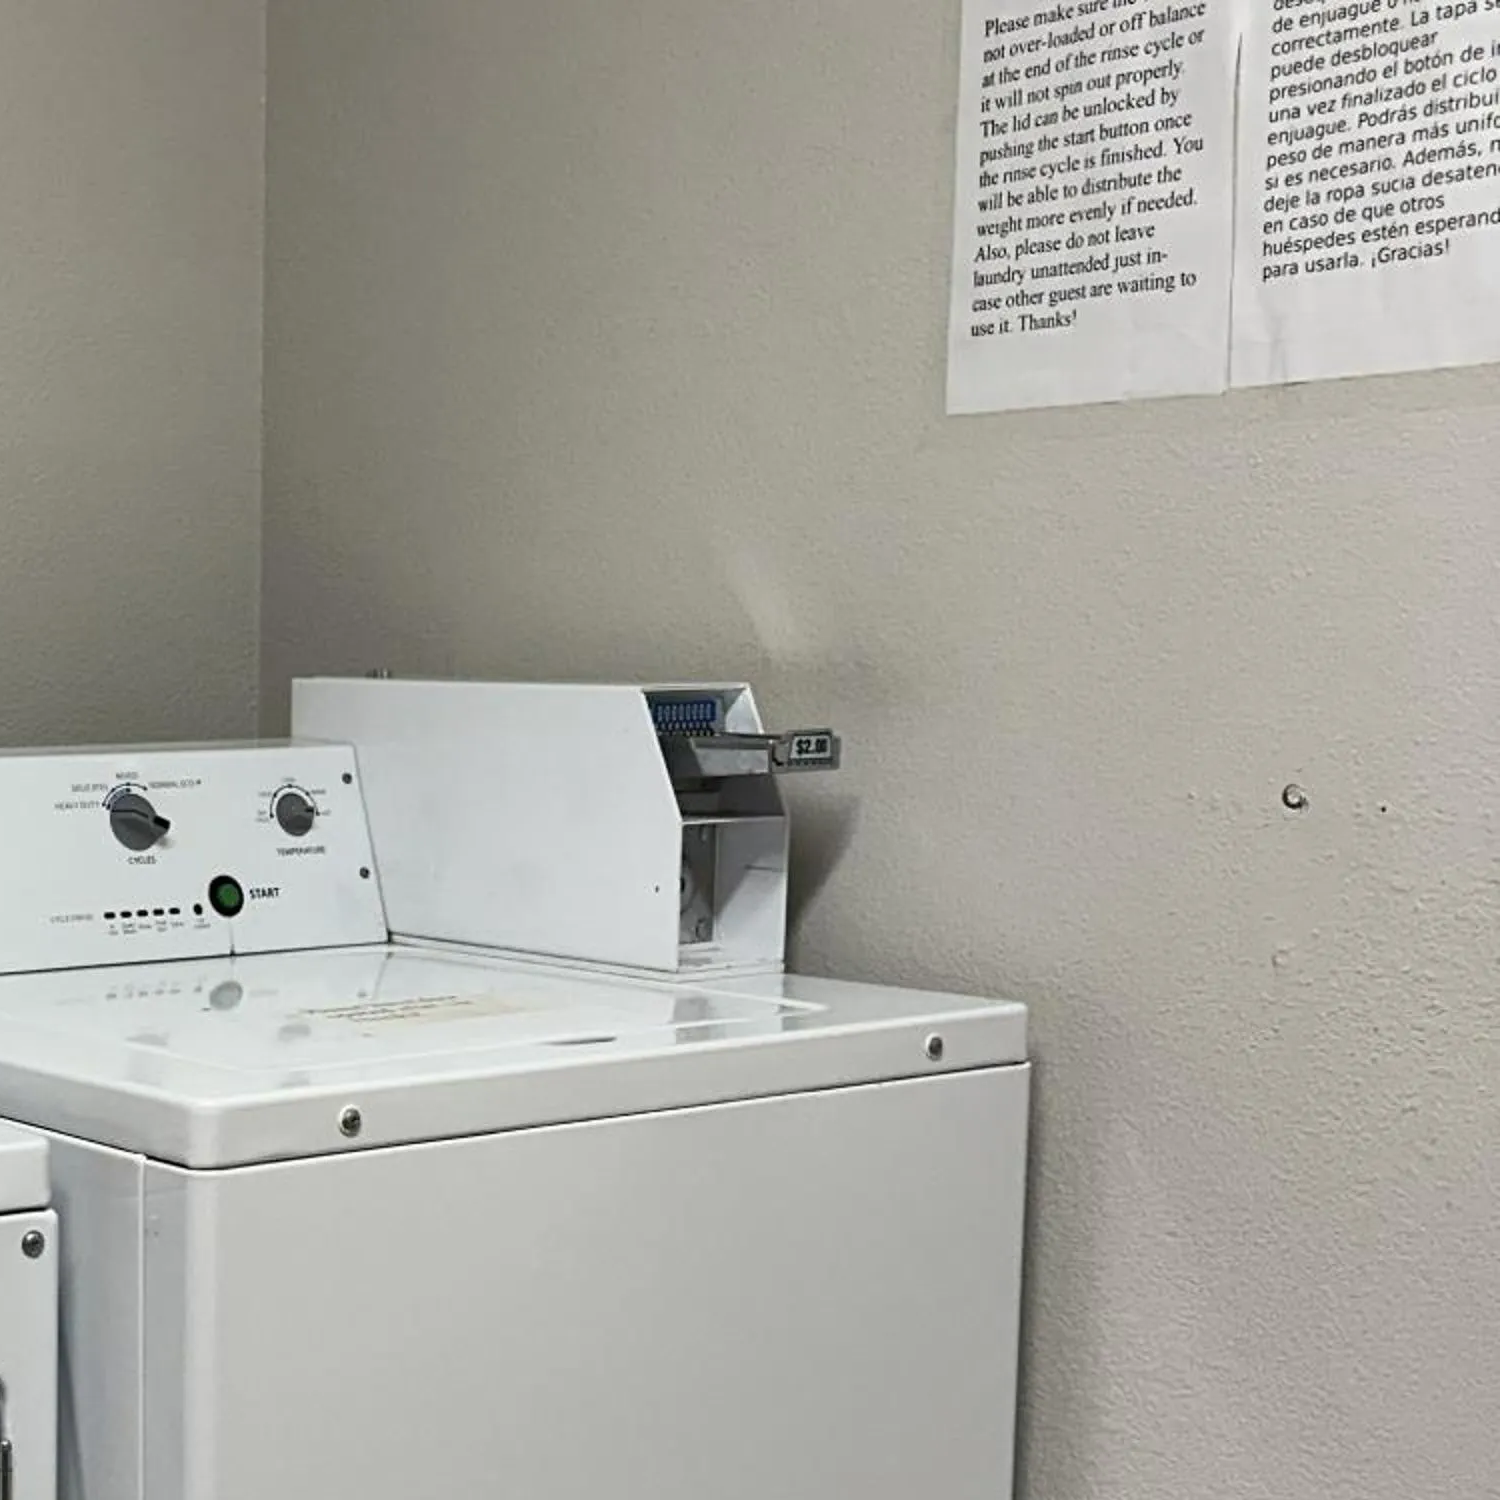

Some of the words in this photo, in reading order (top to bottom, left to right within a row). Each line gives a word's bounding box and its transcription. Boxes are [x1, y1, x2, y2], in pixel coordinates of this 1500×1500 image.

[983, 44, 1006, 64] not
[1009, 21, 1095, 57] over-loaded
[1100, 21, 1116, 38] or
[1119, 10, 1147, 33] off
[1149, 2, 1206, 28] balance
[984, 15, 1030, 38] Please
[1033, 4, 1074, 27] make
[1077, 0, 1108, 17] sure
[1271, 15, 1294, 35] de
[1299, 0, 1382, 29] enjuague
[1411, 10, 1429, 27] La
[1435, 0, 1478, 21] tapa
[982, 71, 995, 89] at
[999, 66, 1021, 85] the
[1025, 57, 1051, 80] end
[1055, 52, 1074, 73] of
[1074, 50, 1097, 69] the
[1101, 44, 1140, 64] rinse
[1144, 31, 1185, 59] cycle
[1188, 29, 1205, 46] or
[1269, 54, 1325, 83] puede
[1330, 31, 1439, 67] desbloquear
[1269, 67, 1378, 105] presionando
[1382, 60, 1399, 80] el
[1403, 52, 1454, 75] botón
[1459, 44, 1485, 63] de
[979, 118, 1008, 139] The
[1013, 111, 1031, 133] lid
[1034, 111, 1059, 128] can
[1062, 104, 1079, 123] be
[1083, 88, 1156, 118] unlocked
[1160, 86, 1179, 108] by
[980, 96, 991, 113] it
[994, 87, 1023, 110] will
[1027, 85, 1050, 105] not
[1053, 80, 1083, 102] spin
[1086, 73, 1111, 91] out
[1268, 105, 1301, 124] una
[1306, 98, 1337, 117] vez
[1341, 79, 1427, 110] finalizado
[1431, 72, 1447, 93] el
[1453, 65, 1498, 89] ciclo
[1357, 103, 1417, 129] Podrás
[979, 141, 1035, 168] pushing
[1037, 134, 1058, 153] the
[1063, 128, 1096, 148] start
[1099, 120, 1150, 141] button
[1154, 113, 1193, 132] once
[979, 170, 999, 189] the
[1002, 166, 1036, 185] rinse
[1039, 155, 1081, 180] cycle
[1083, 155, 1096, 169] is
[1100, 139, 1167, 167] finished.
[1173, 135, 1204, 155] You
[1266, 149, 1307, 172] peso
[1311, 143, 1333, 161] de
[1338, 131, 1406, 155] manera
[1411, 121, 1449, 143] más
[1264, 176, 1279, 192] si
[1284, 171, 1304, 188] es
[1308, 156, 1396, 183] necesario.
[1402, 139, 1482, 168] Además,
[977, 191, 1003, 212] will
[1007, 190, 1024, 208] be
[1027, 183, 1059, 205] able
[1062, 184, 1079, 199] to
[1081, 172, 1153, 196] distribute
[1156, 165, 1183, 185] the
[1263, 194, 1301, 214] deje
[1305, 189, 1321, 206] la
[1326, 183, 1365, 204] ropa
[1371, 175, 1416, 197] sucia
[976, 215, 1023, 239] weight
[1025, 212, 1065, 230] more
[1069, 200, 1117, 224] evenly
[1120, 195, 1134, 216] if
[1136, 187, 1198, 214] needed.
[1262, 219, 1283, 235] en
[1289, 212, 1329, 231] caso
[1334, 206, 1357, 225] de
[1361, 202, 1395, 223] que
[1399, 194, 1445, 215] otros
[973, 243, 1011, 263] Also,
[1015, 237, 1062, 262] please
[1065, 231, 1084, 251] do
[1087, 229, 1111, 247] not
[1114, 224, 1156, 243] leave
[1262, 230, 1356, 257] huéspedes
[1361, 221, 1409, 244] estén
[1262, 261, 1299, 283] para
[1371, 237, 1450, 269] ¡Gracias!
[973, 265, 1025, 288] laundry
[1030, 252, 1110, 280] unattended
[1111, 251, 1142, 274] just
[971, 296, 1001, 313] case
[1005, 288, 1045, 309] other
[1048, 285, 1087, 308] guest
[1089, 282, 1113, 298] are
[1116, 272, 1176, 294] waiting
[1180, 272, 1197, 287] to
[971, 322, 995, 337] use
[1017, 308, 1077, 332] Thanks!
[249, 887, 280, 899] START
